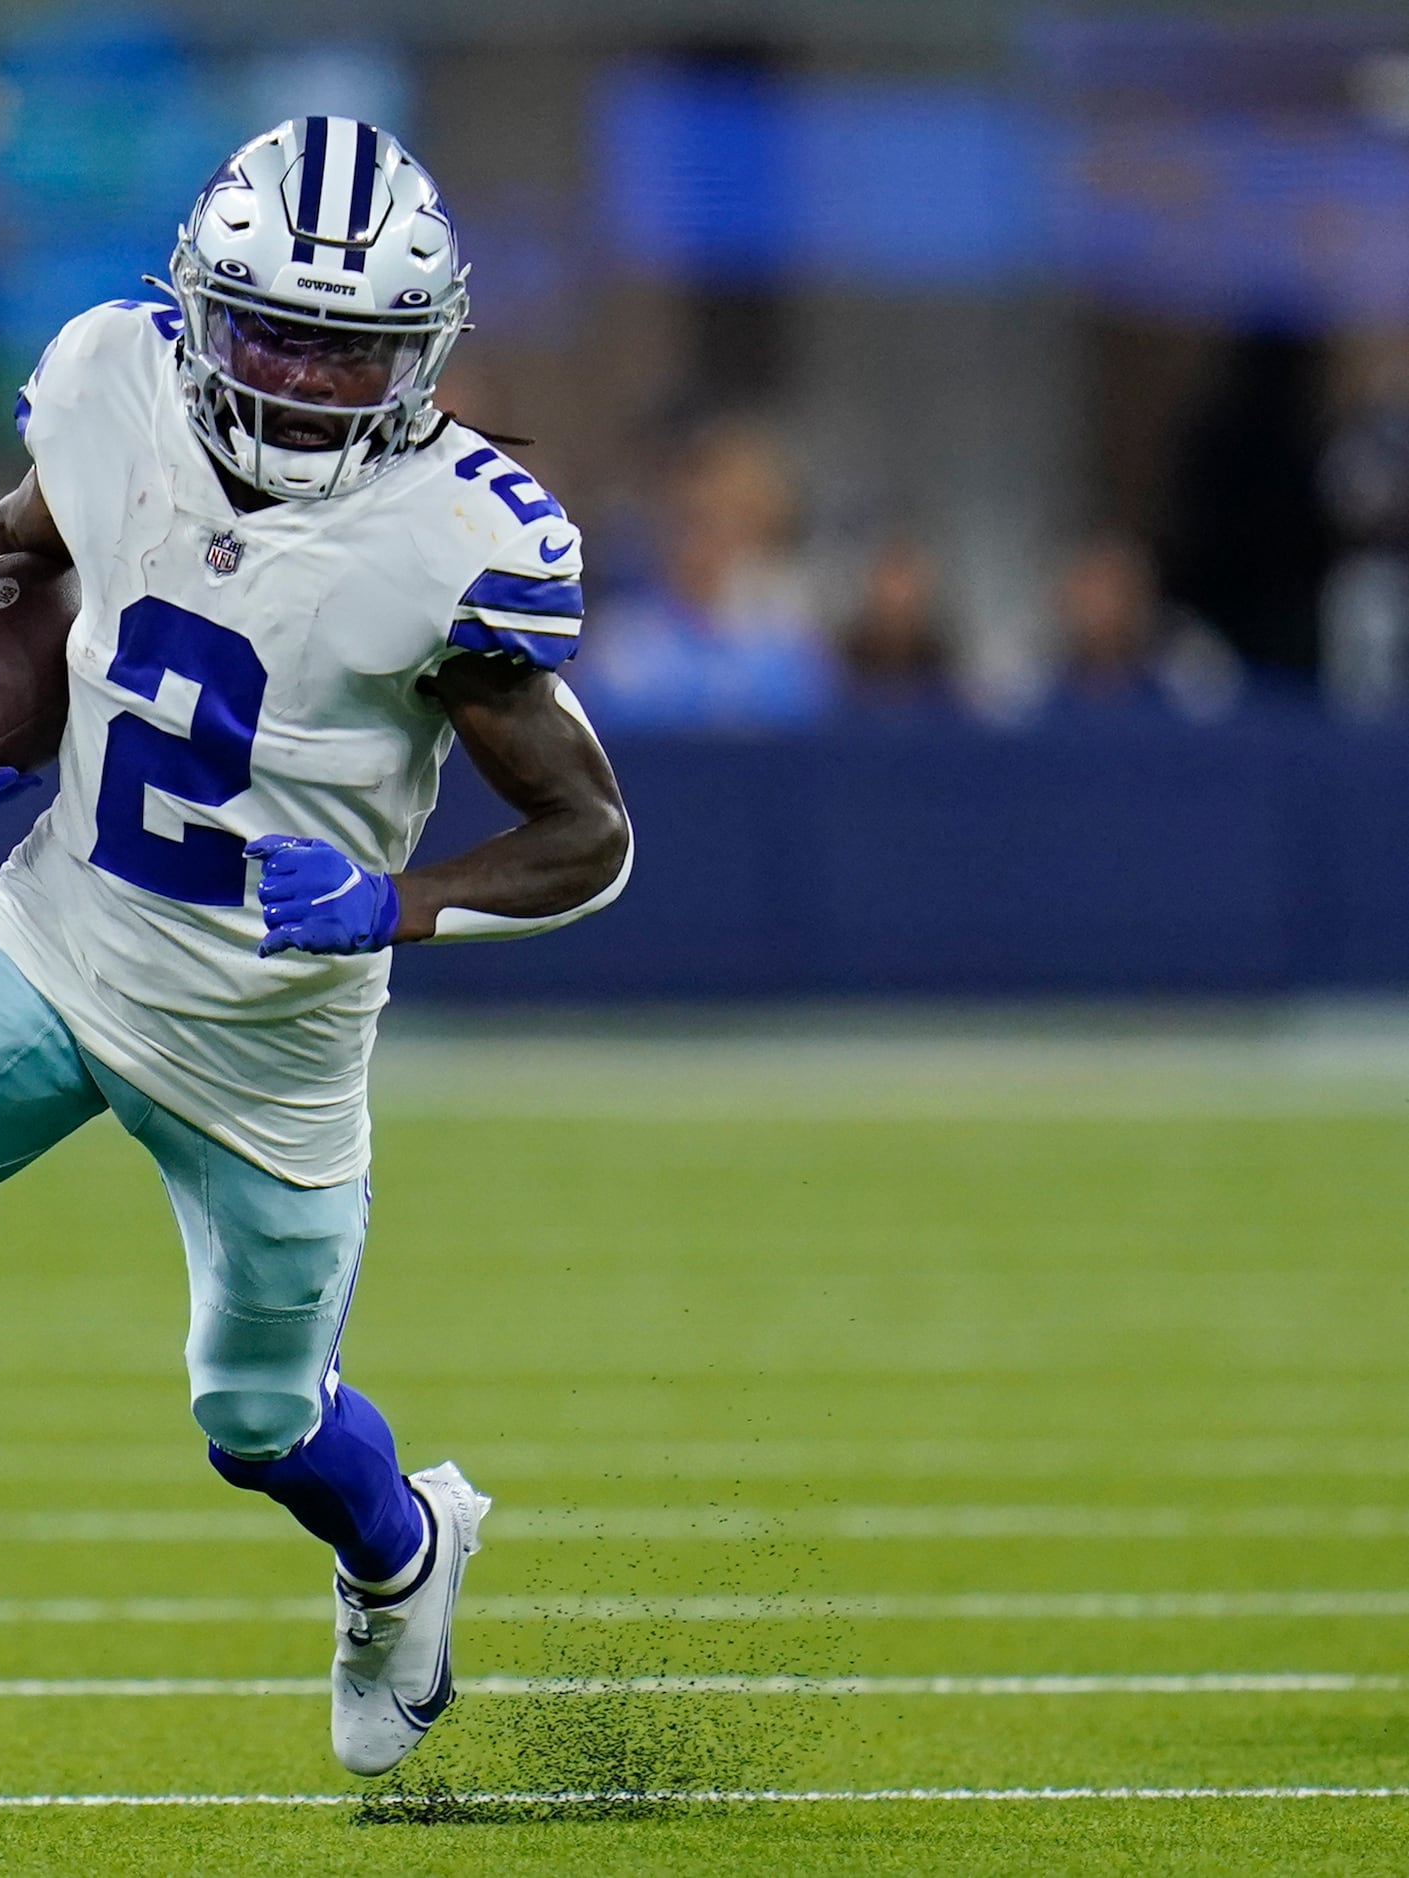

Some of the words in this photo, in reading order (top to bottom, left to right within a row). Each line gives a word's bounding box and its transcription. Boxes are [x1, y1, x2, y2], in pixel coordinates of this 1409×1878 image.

[297, 277, 357, 296] COWBOYS
[455, 448, 564, 525] 2
[210, 547, 234, 570] NFL
[88, 595, 268, 906] 2
